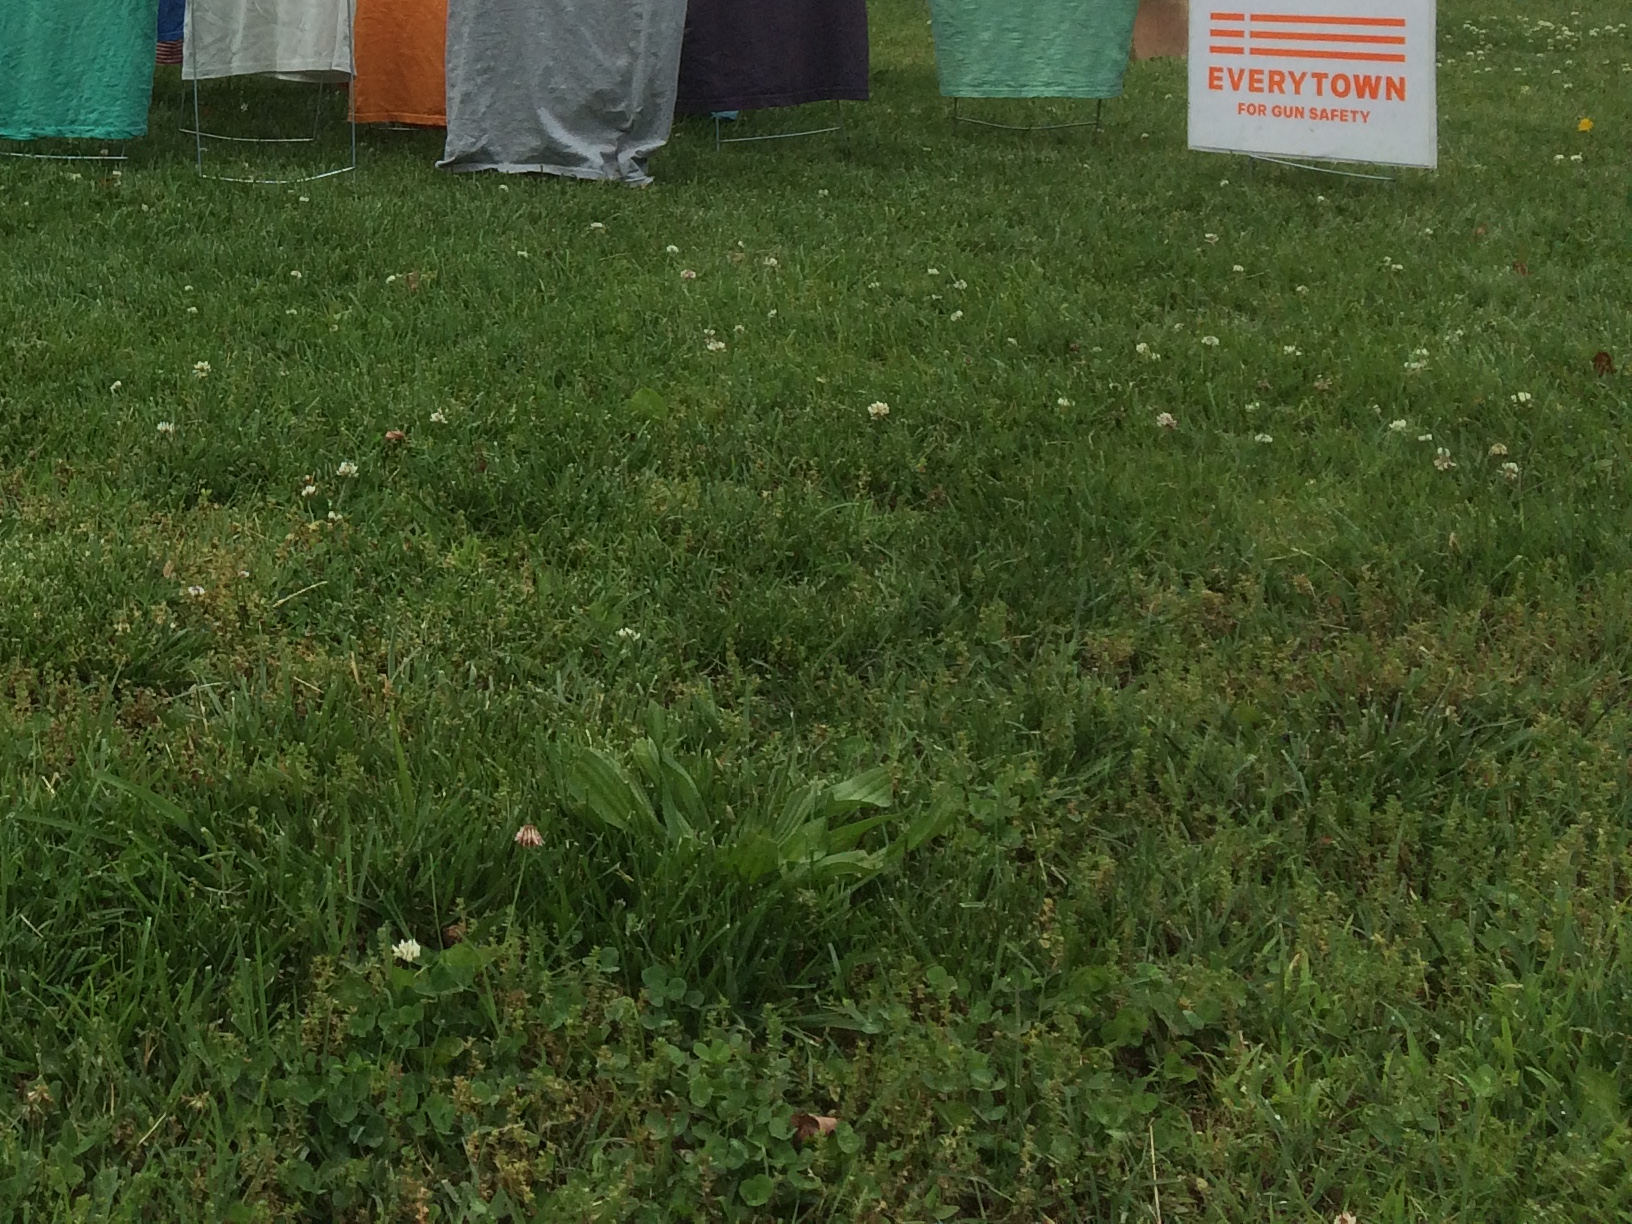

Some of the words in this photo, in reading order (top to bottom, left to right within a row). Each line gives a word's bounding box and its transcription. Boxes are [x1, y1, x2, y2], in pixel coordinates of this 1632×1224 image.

[1208, 66, 1406, 102] EVERYTOWN
[1237, 102, 1267, 116] FOR
[1271, 104, 1305, 119] GUN
[1309, 107, 1371, 124] SAFETY
